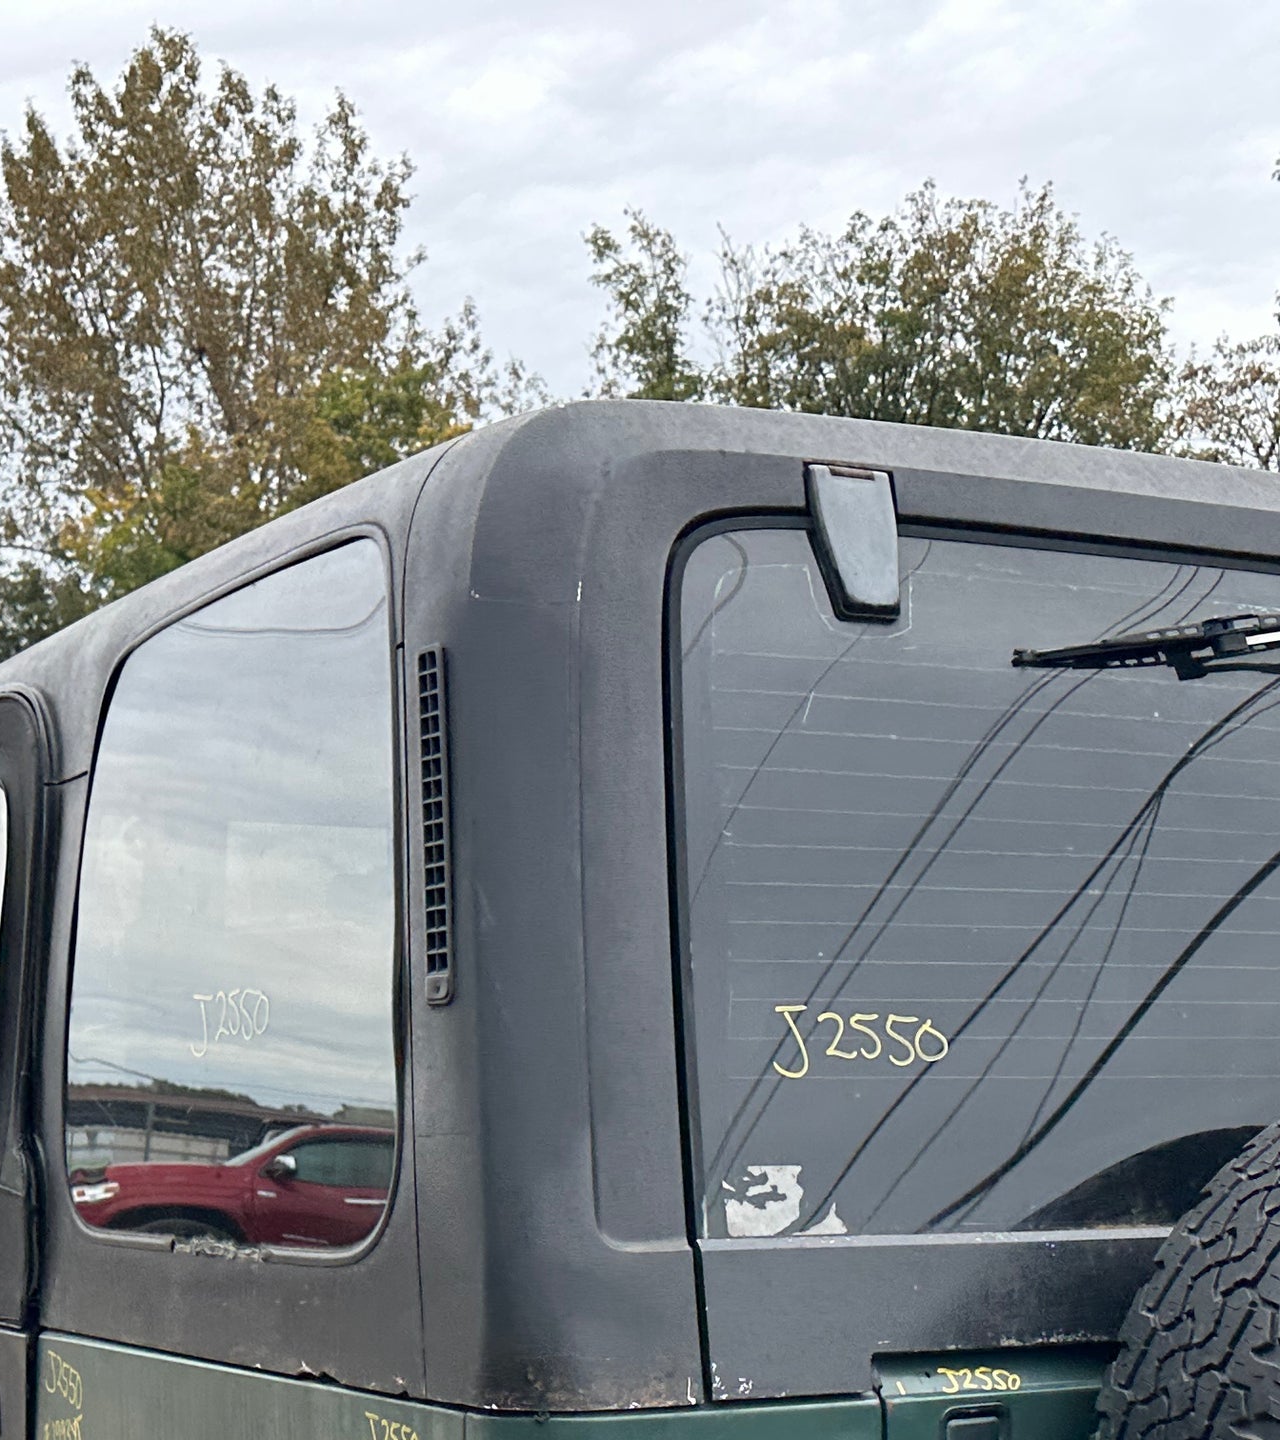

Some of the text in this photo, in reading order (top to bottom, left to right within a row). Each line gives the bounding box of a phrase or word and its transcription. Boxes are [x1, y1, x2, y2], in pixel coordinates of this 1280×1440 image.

[190, 988, 270, 1058] J2550
[773, 1004, 949, 1079] J2550
[937, 1366, 1021, 1393] J2550
